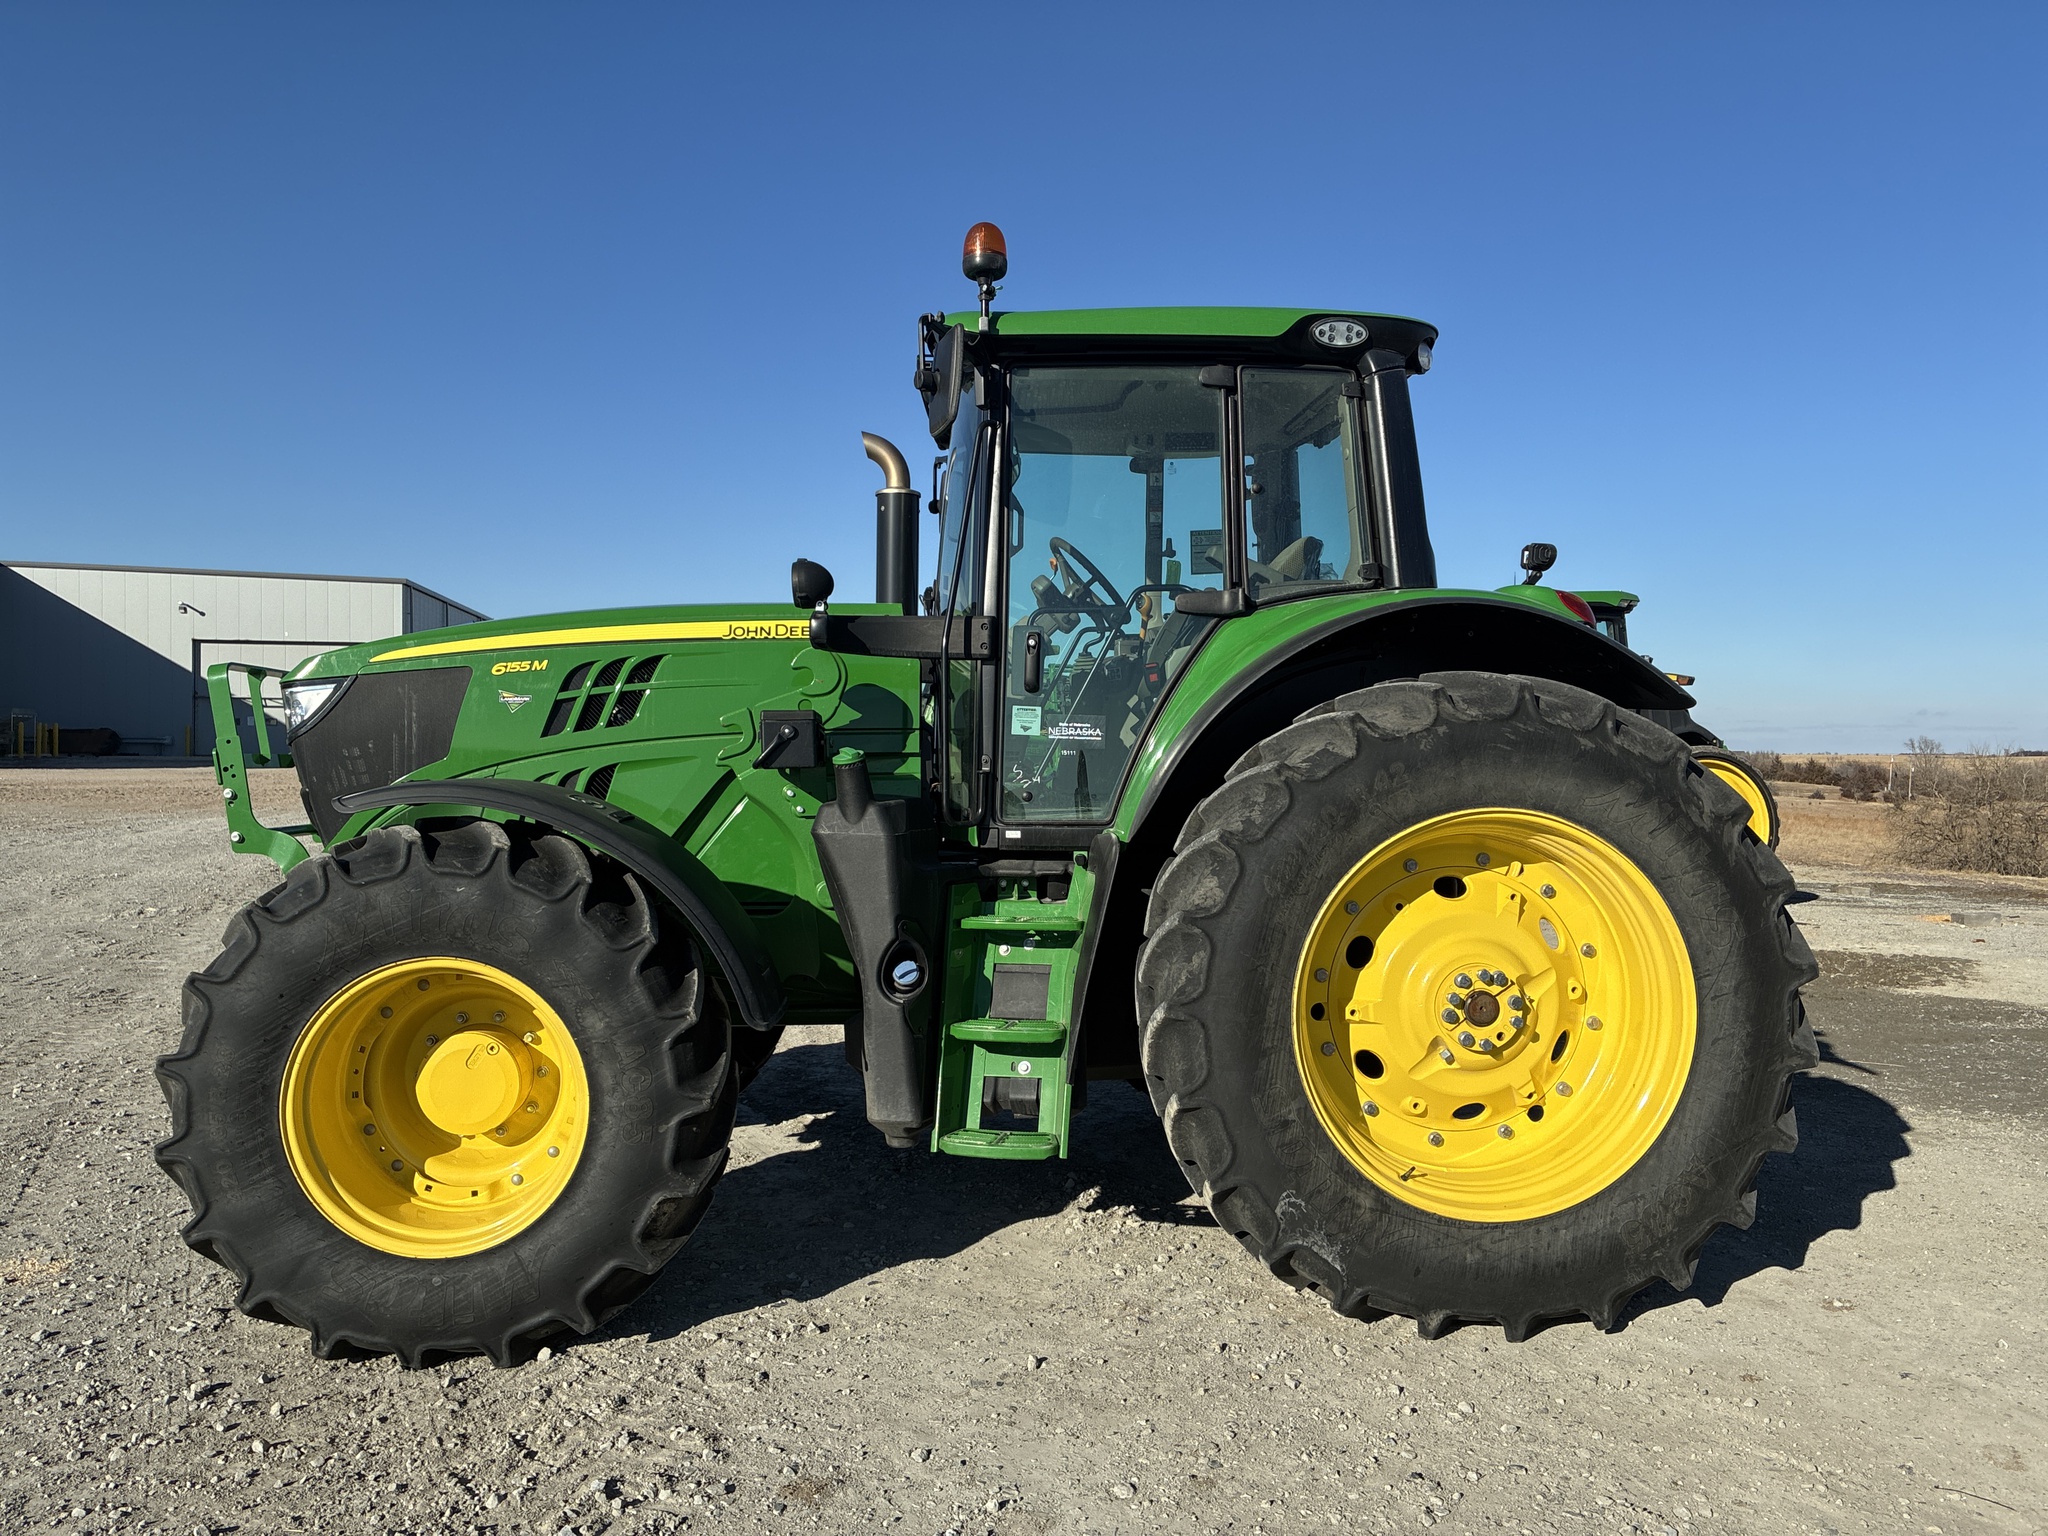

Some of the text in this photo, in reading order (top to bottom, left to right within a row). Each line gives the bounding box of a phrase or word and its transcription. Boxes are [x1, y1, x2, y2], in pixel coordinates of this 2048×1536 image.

[722, 624, 810, 637] JOHN DEE
[1048, 726, 1102, 737] NEBRASKA
[612, 1038, 655, 1146] AC85
